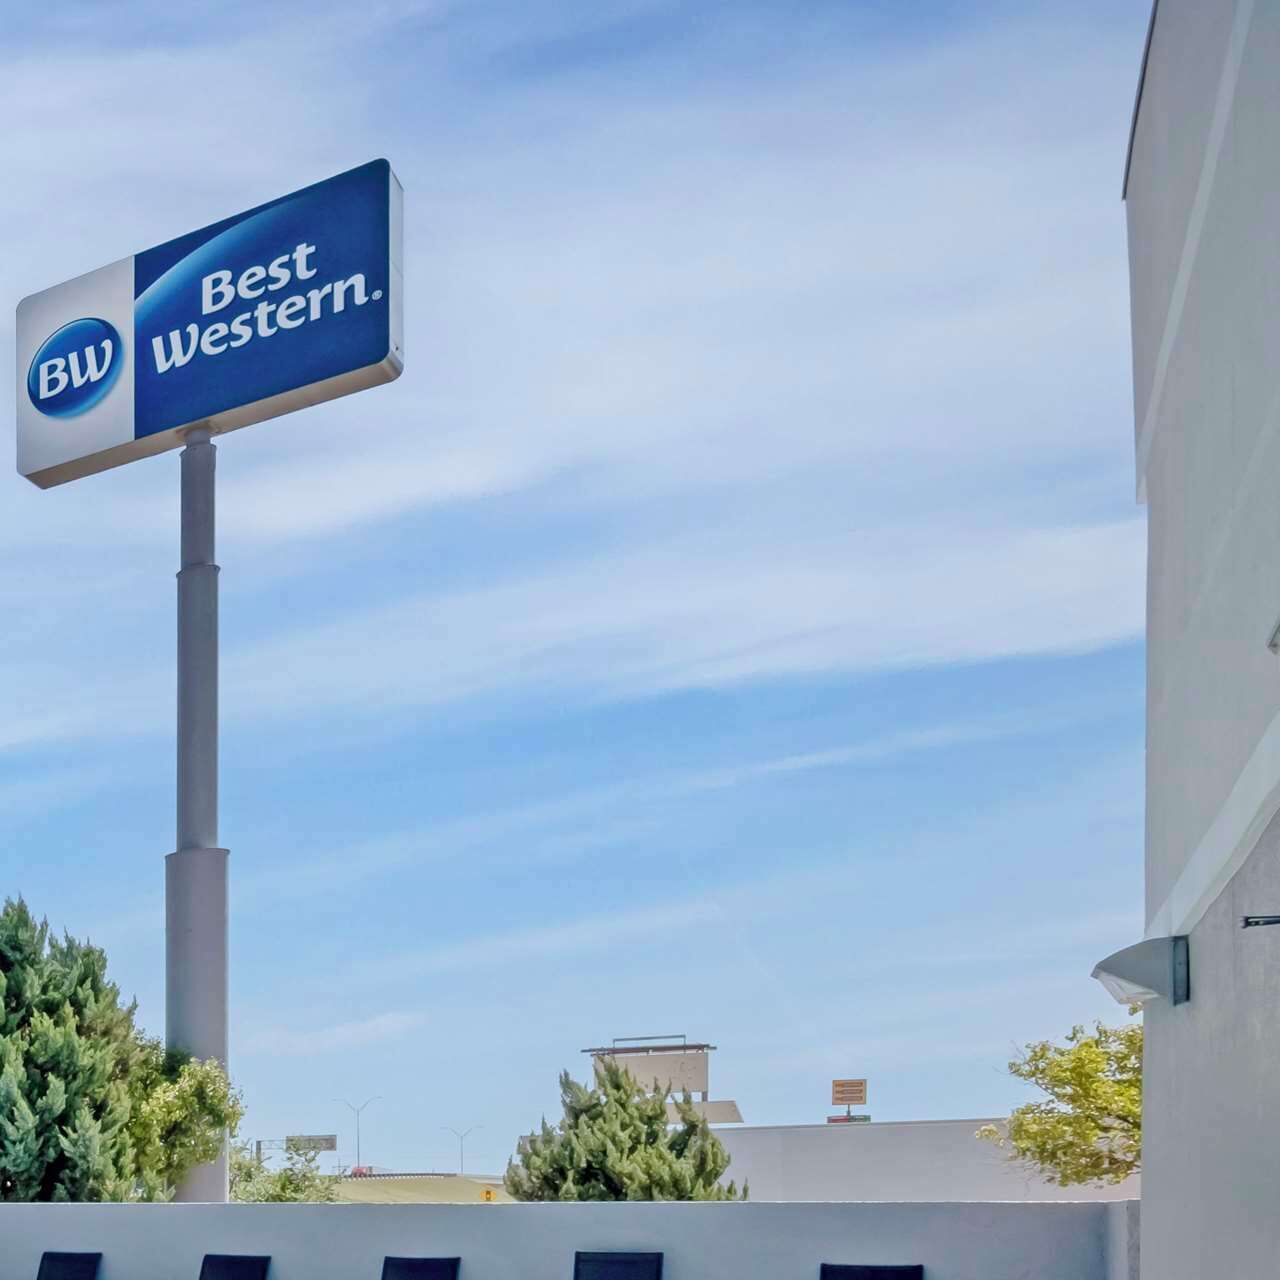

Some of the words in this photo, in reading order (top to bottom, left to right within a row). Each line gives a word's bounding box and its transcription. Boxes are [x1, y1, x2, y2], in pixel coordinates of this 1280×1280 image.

[200, 241, 319, 316] Best
[150, 272, 370, 375] Western
[38, 337, 115, 401] BW
